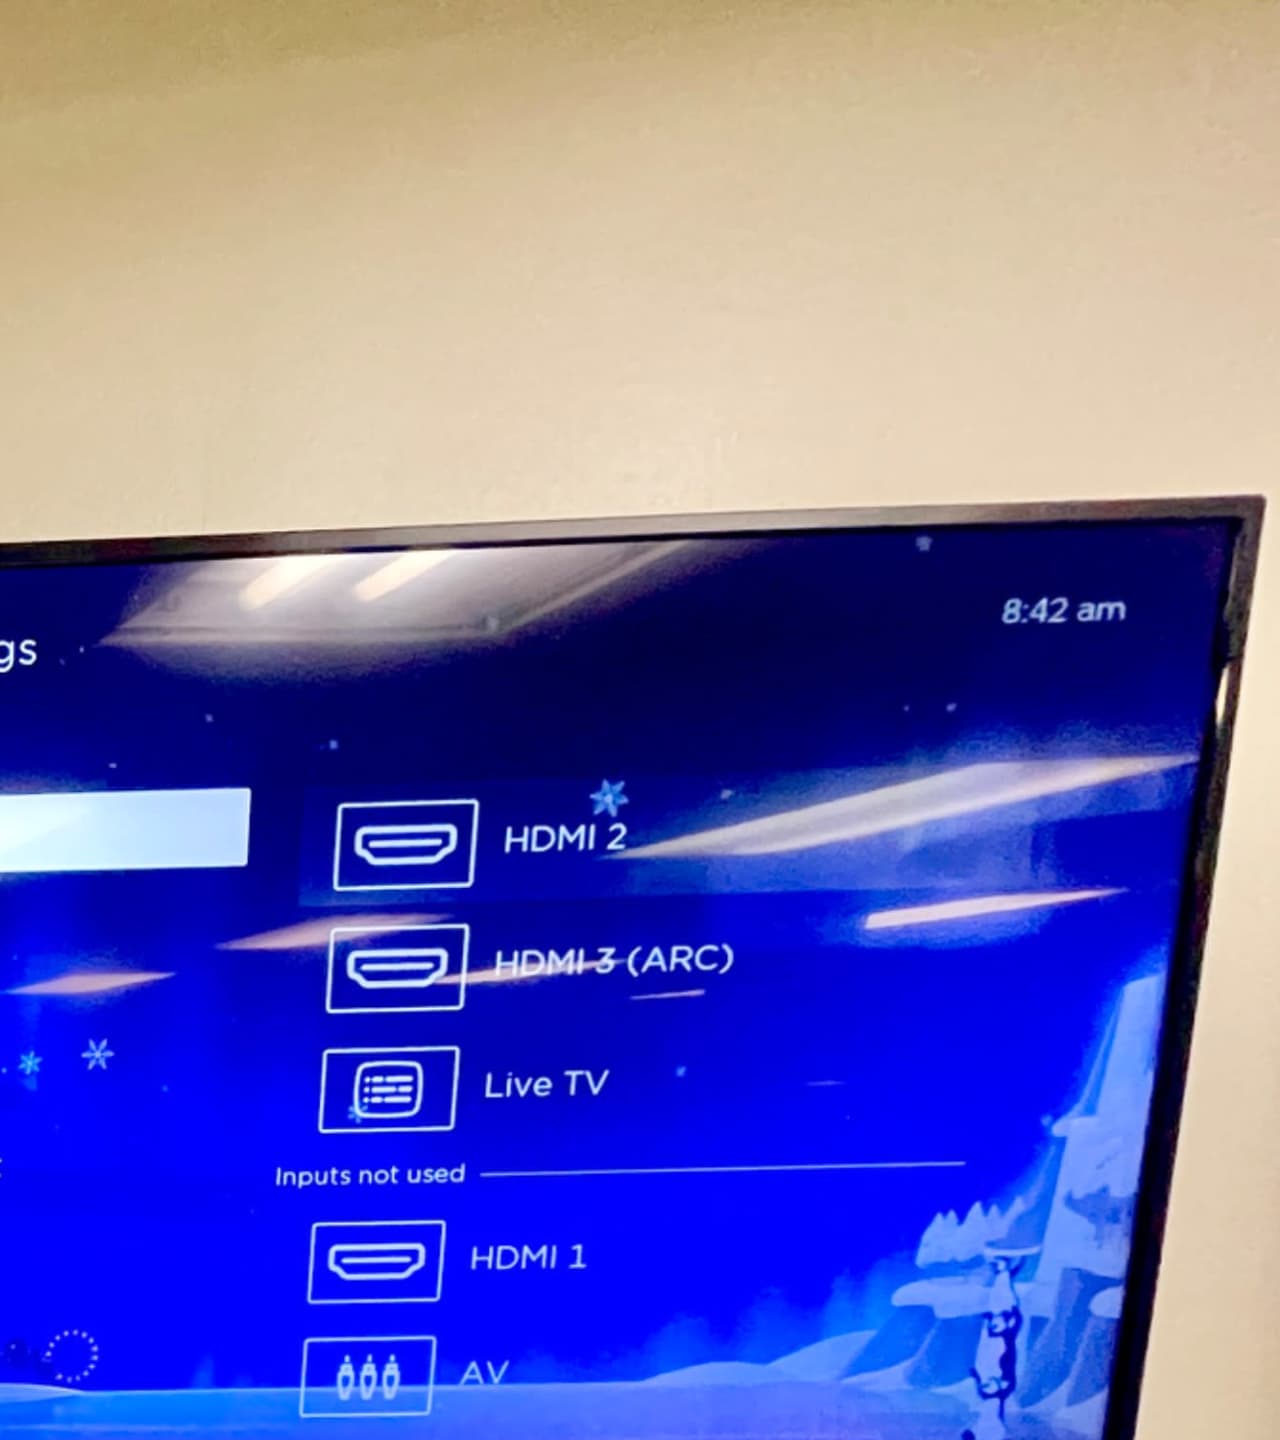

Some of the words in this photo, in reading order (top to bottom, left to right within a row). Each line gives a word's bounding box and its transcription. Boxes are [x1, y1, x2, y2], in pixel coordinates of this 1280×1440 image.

[1001, 597, 1069, 624] 8:42
[1077, 600, 1126, 622] am
[503, 825, 596, 854] HDMI
[605, 823, 628, 851] 2
[493, 948, 587, 978] HDMI
[594, 947, 617, 974] 3
[626, 944, 734, 978] (ARC)
[483, 1070, 553, 1099] Live
[563, 1069, 609, 1097] TV
[274, 1164, 351, 1189] Inputs
[357, 1164, 401, 1186] not
[407, 1161, 467, 1185] used
[470, 1245, 558, 1272] HDMI
[568, 1244, 587, 1269] 1
[459, 1361, 509, 1385] AV
